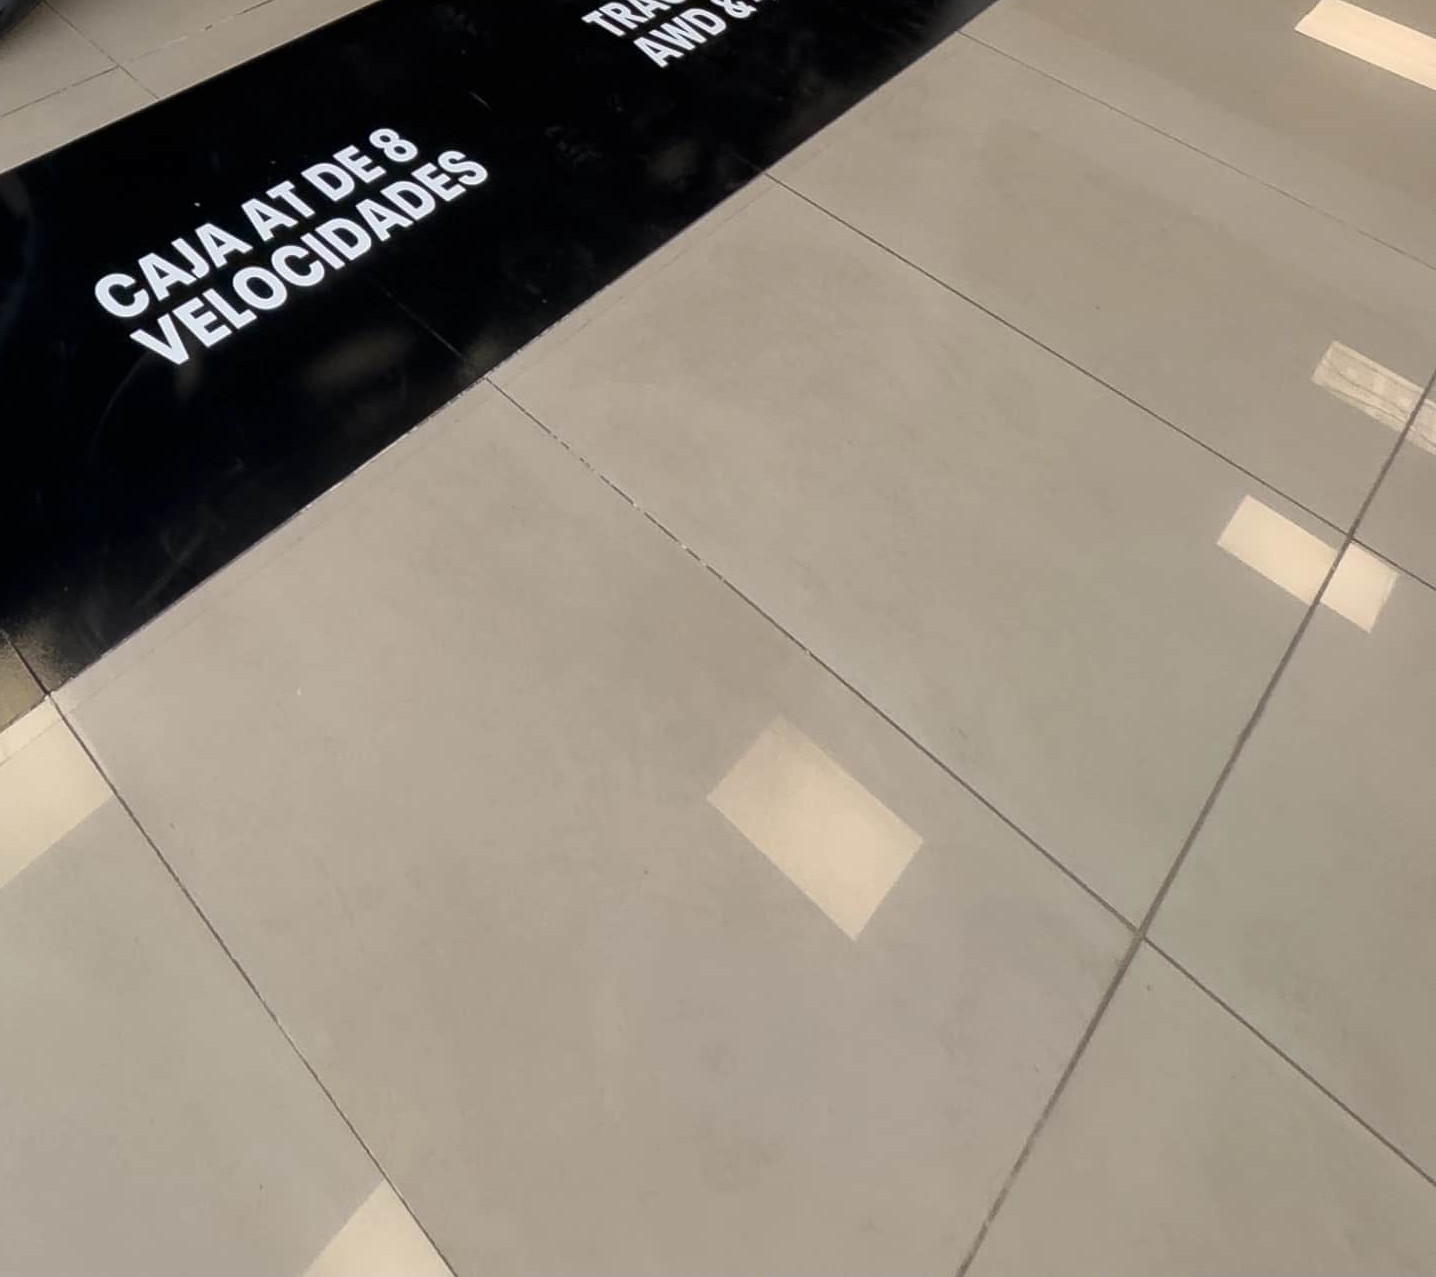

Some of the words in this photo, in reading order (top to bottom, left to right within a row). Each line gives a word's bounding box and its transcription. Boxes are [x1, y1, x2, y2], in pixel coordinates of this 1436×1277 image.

[633, 7, 727, 68] AWD
[94, 223, 253, 318] CAJA
[241, 180, 315, 241] AT
[301, 145, 386, 202] DE
[369, 128, 418, 162] 8
[129, 150, 488, 366] VELOCIDADES
